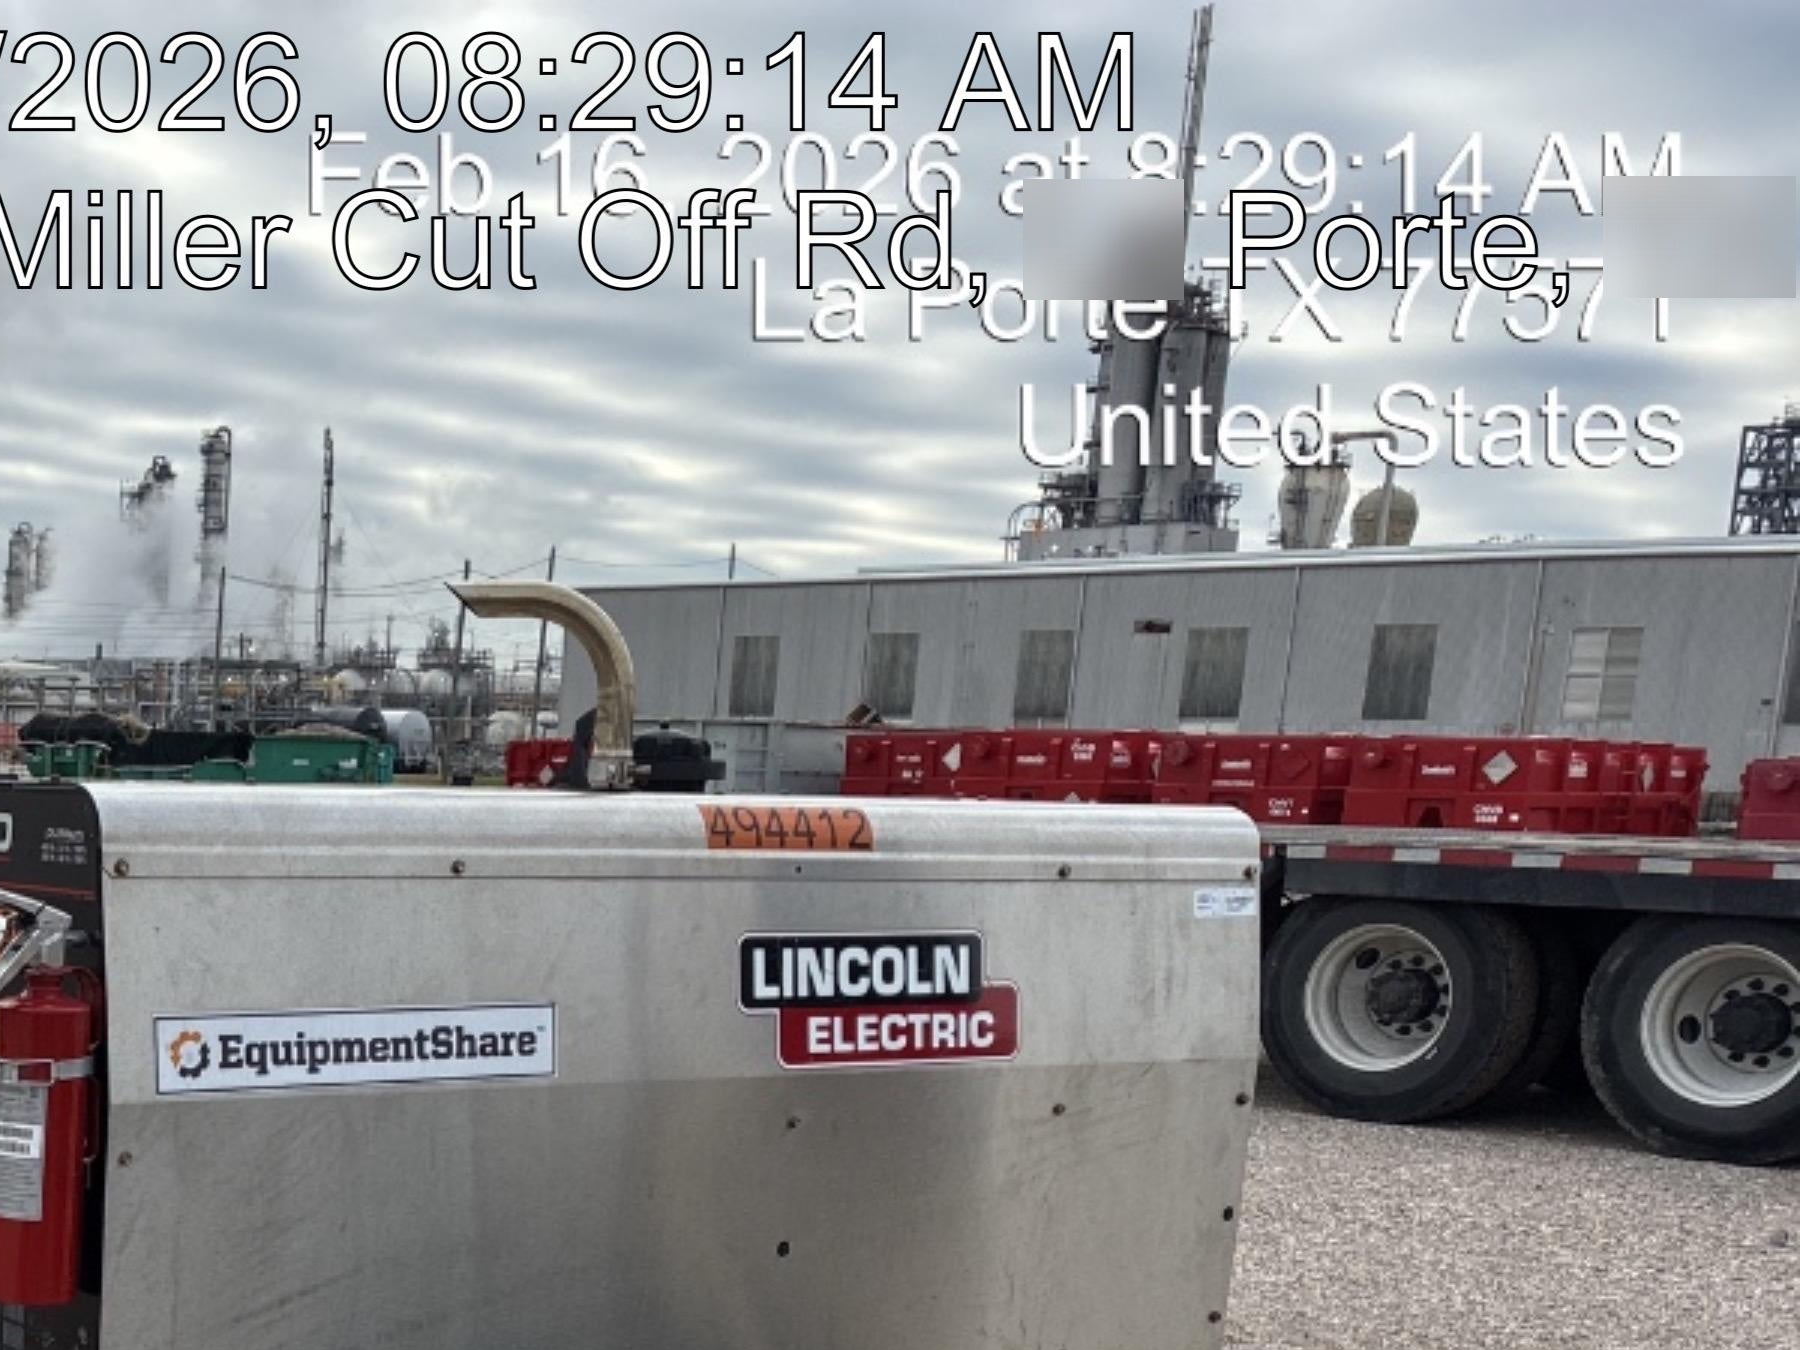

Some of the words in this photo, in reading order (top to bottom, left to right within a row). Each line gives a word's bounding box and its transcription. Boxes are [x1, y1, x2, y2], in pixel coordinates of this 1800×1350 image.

[709, 806, 872, 849] 494412
[752, 944, 970, 999] LINCOLN
[218, 1025, 539, 1074] EquipmentShare
[807, 1010, 995, 1054] ELECTRIC
